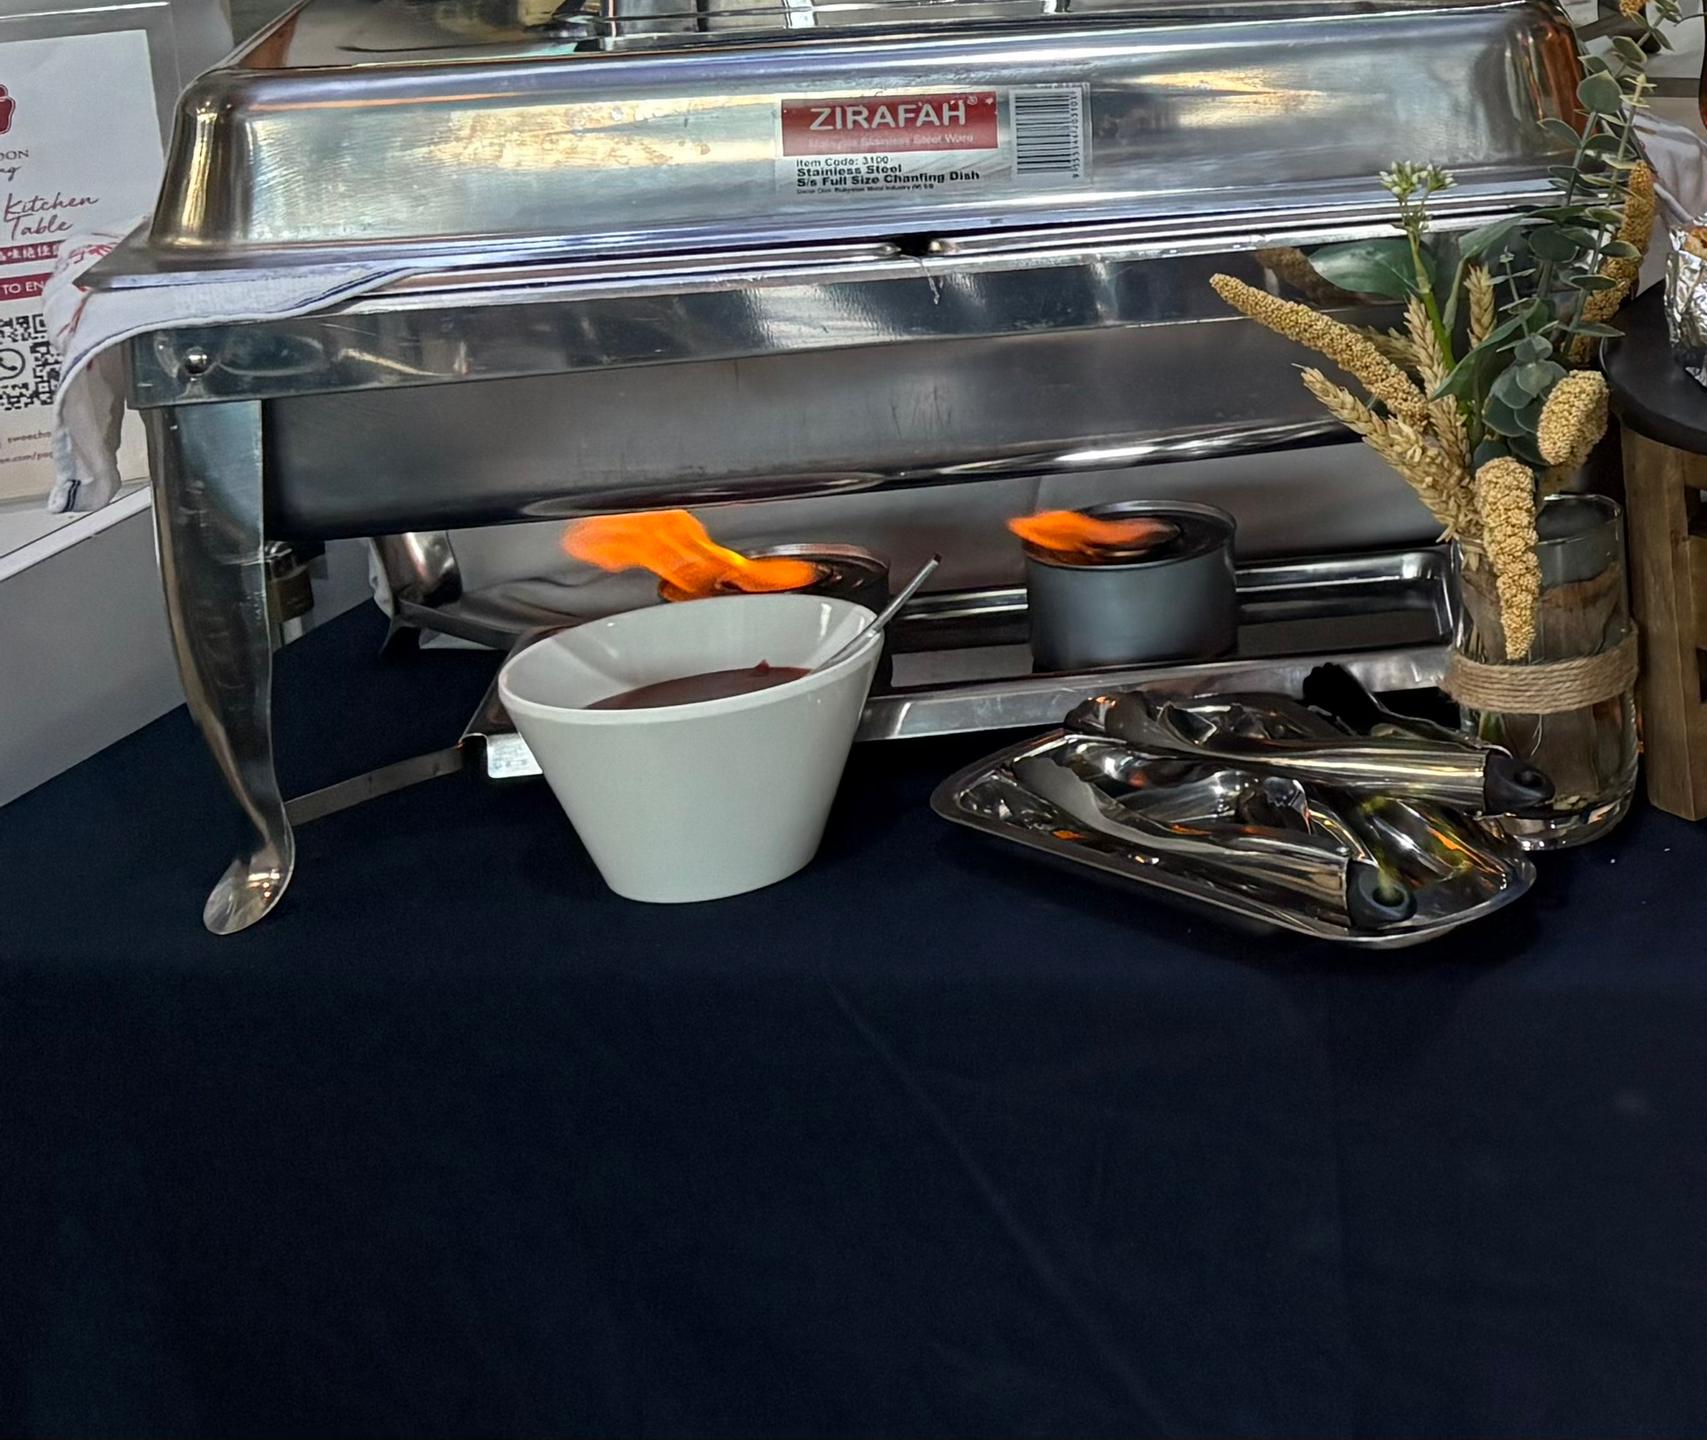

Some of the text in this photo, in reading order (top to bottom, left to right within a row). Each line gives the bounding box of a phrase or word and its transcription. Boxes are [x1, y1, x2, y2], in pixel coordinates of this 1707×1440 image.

[810, 102, 966, 131] ZIRAFAH
[797, 155, 889, 167] Item Code: 3100
[797, 164, 902, 177] Stainless Steel
[822, 176, 847, 186] Full
[851, 174, 880, 185] Size
[949, 169, 980, 181] Dish
[4, 192, 99, 222] Kitchen
[11, 213, 73, 241] Table
[2, 281, 44, 295] TO EN
